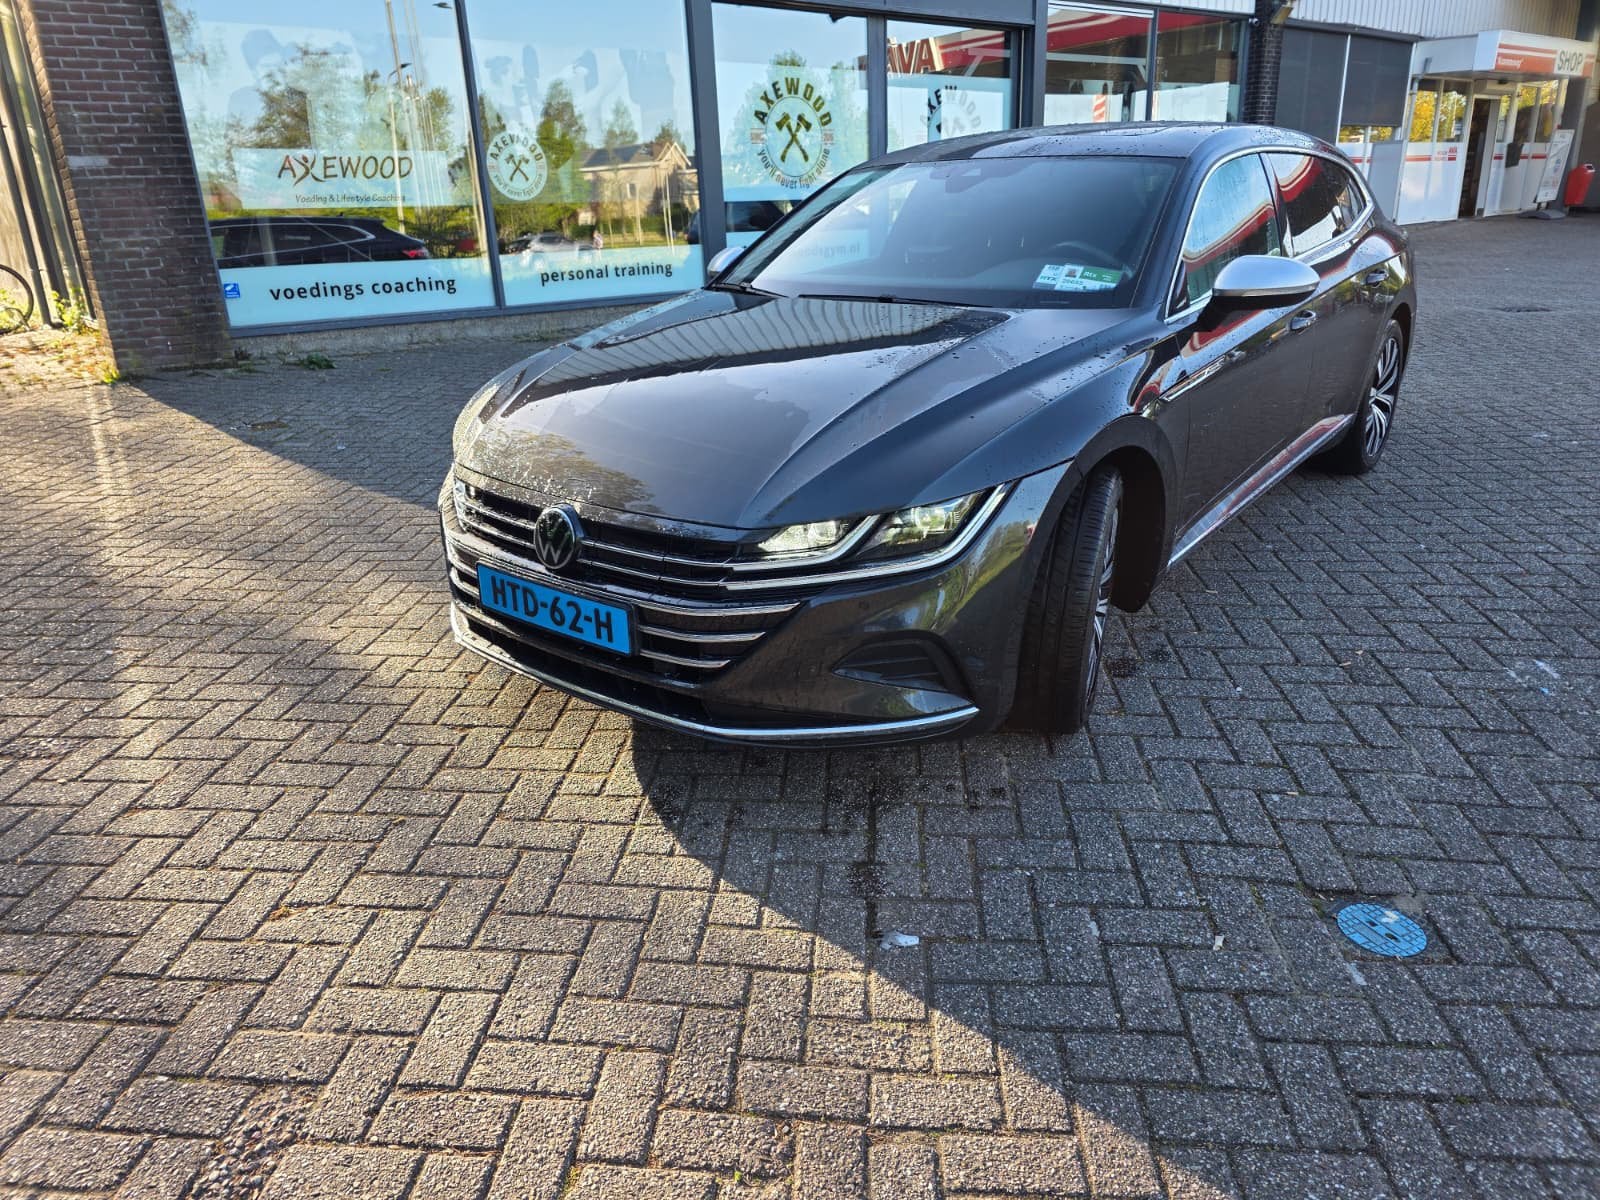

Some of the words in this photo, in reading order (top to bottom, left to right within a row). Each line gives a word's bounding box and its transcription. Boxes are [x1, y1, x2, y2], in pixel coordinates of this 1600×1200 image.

[1557, 50, 1584, 72] SHOP
[754, 77, 832, 126] AXEWOOD
[277, 153, 413, 187] AXEWOOD
[757, 149, 777, 177] you'll
[775, 173, 798, 189] never
[296, 194, 327, 205] Voeding
[329, 194, 335, 202] &
[336, 194, 371, 203] Lifestyle
[269, 282, 364, 301] voedings
[371, 277, 457, 295] coaching
[541, 265, 609, 287] personal
[615, 262, 673, 277] training
[490, 574, 614, 643] HTD-62-H
